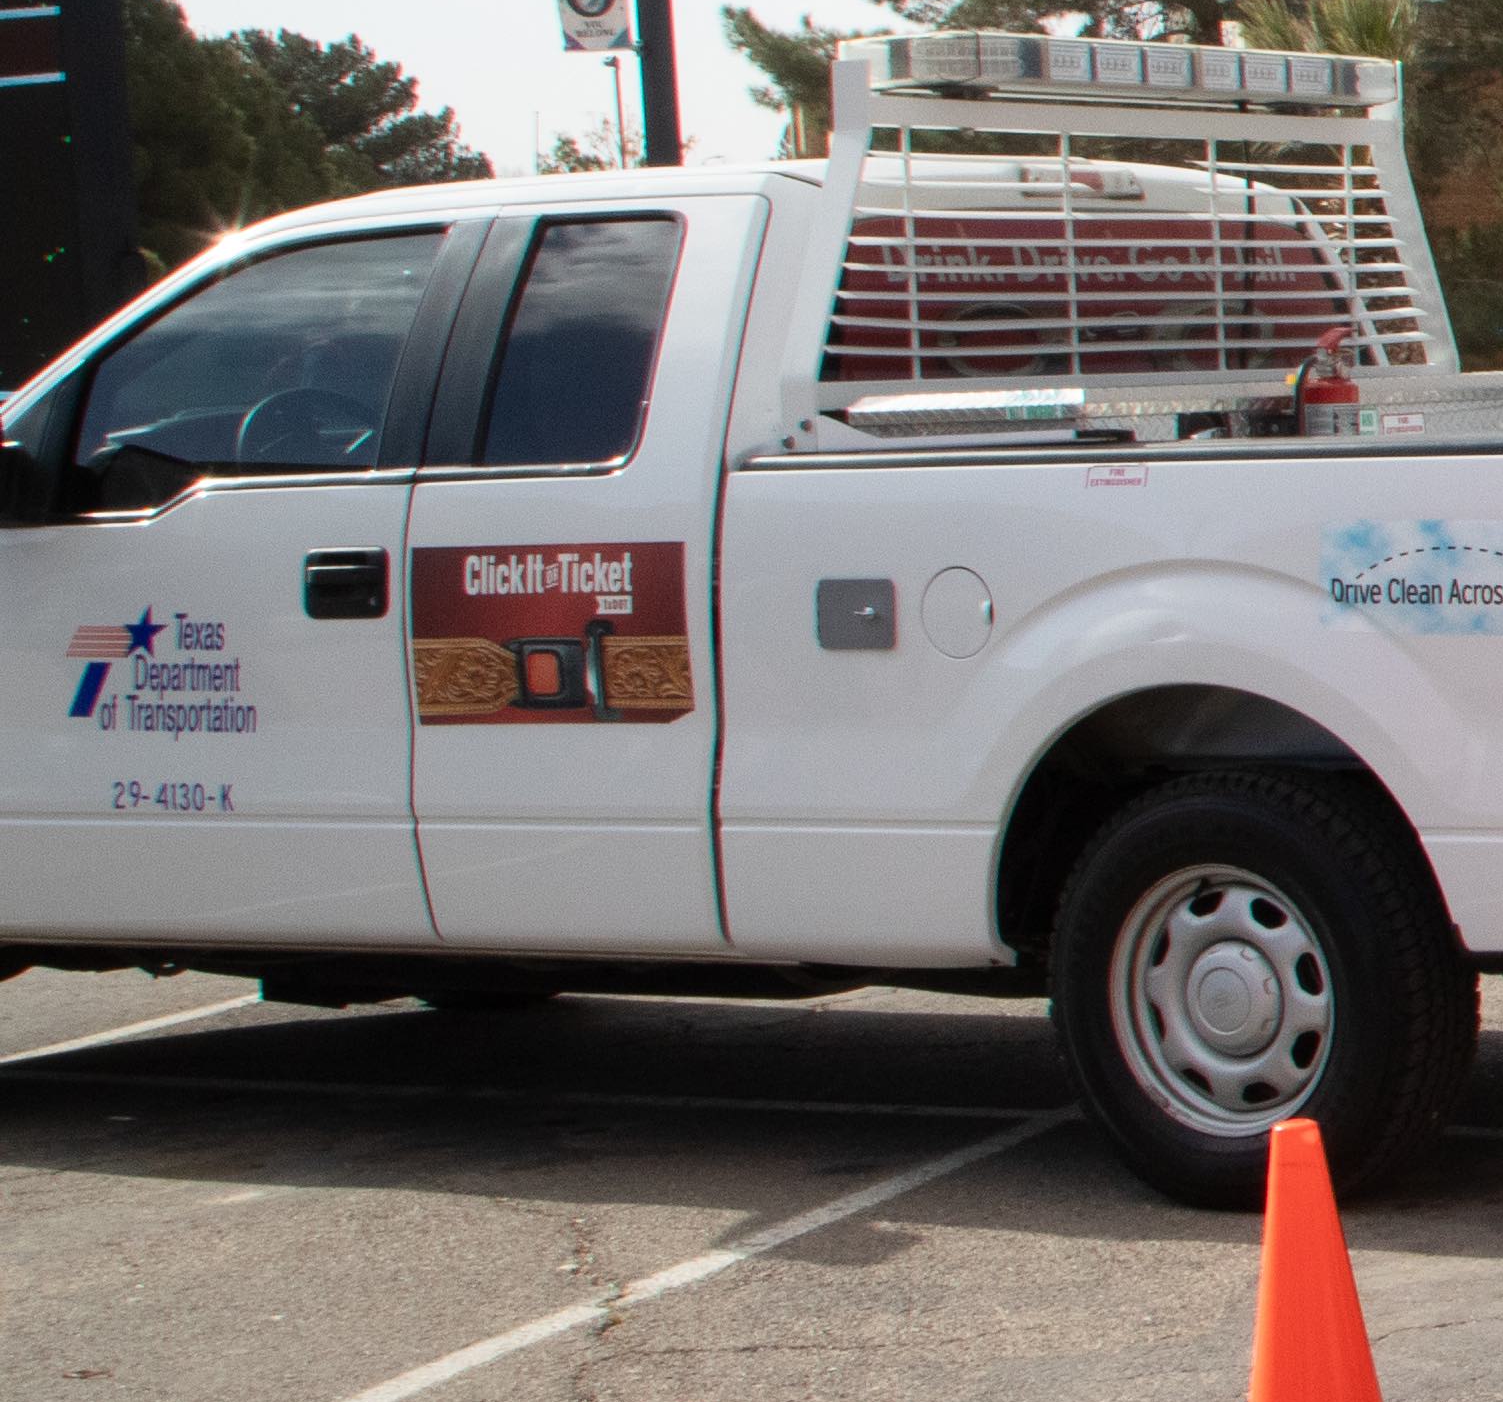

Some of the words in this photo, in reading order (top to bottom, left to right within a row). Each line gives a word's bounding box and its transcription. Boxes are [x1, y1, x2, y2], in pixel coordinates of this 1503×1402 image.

[558, 551, 633, 593] Ticket
[1330, 578, 1383, 606] Drive
[1388, 577, 1443, 606] Clean
[174, 612, 225, 652] Texas
[134, 655, 241, 695] Department
[100, 697, 118, 732] of
[127, 696, 258, 742] Transportation
